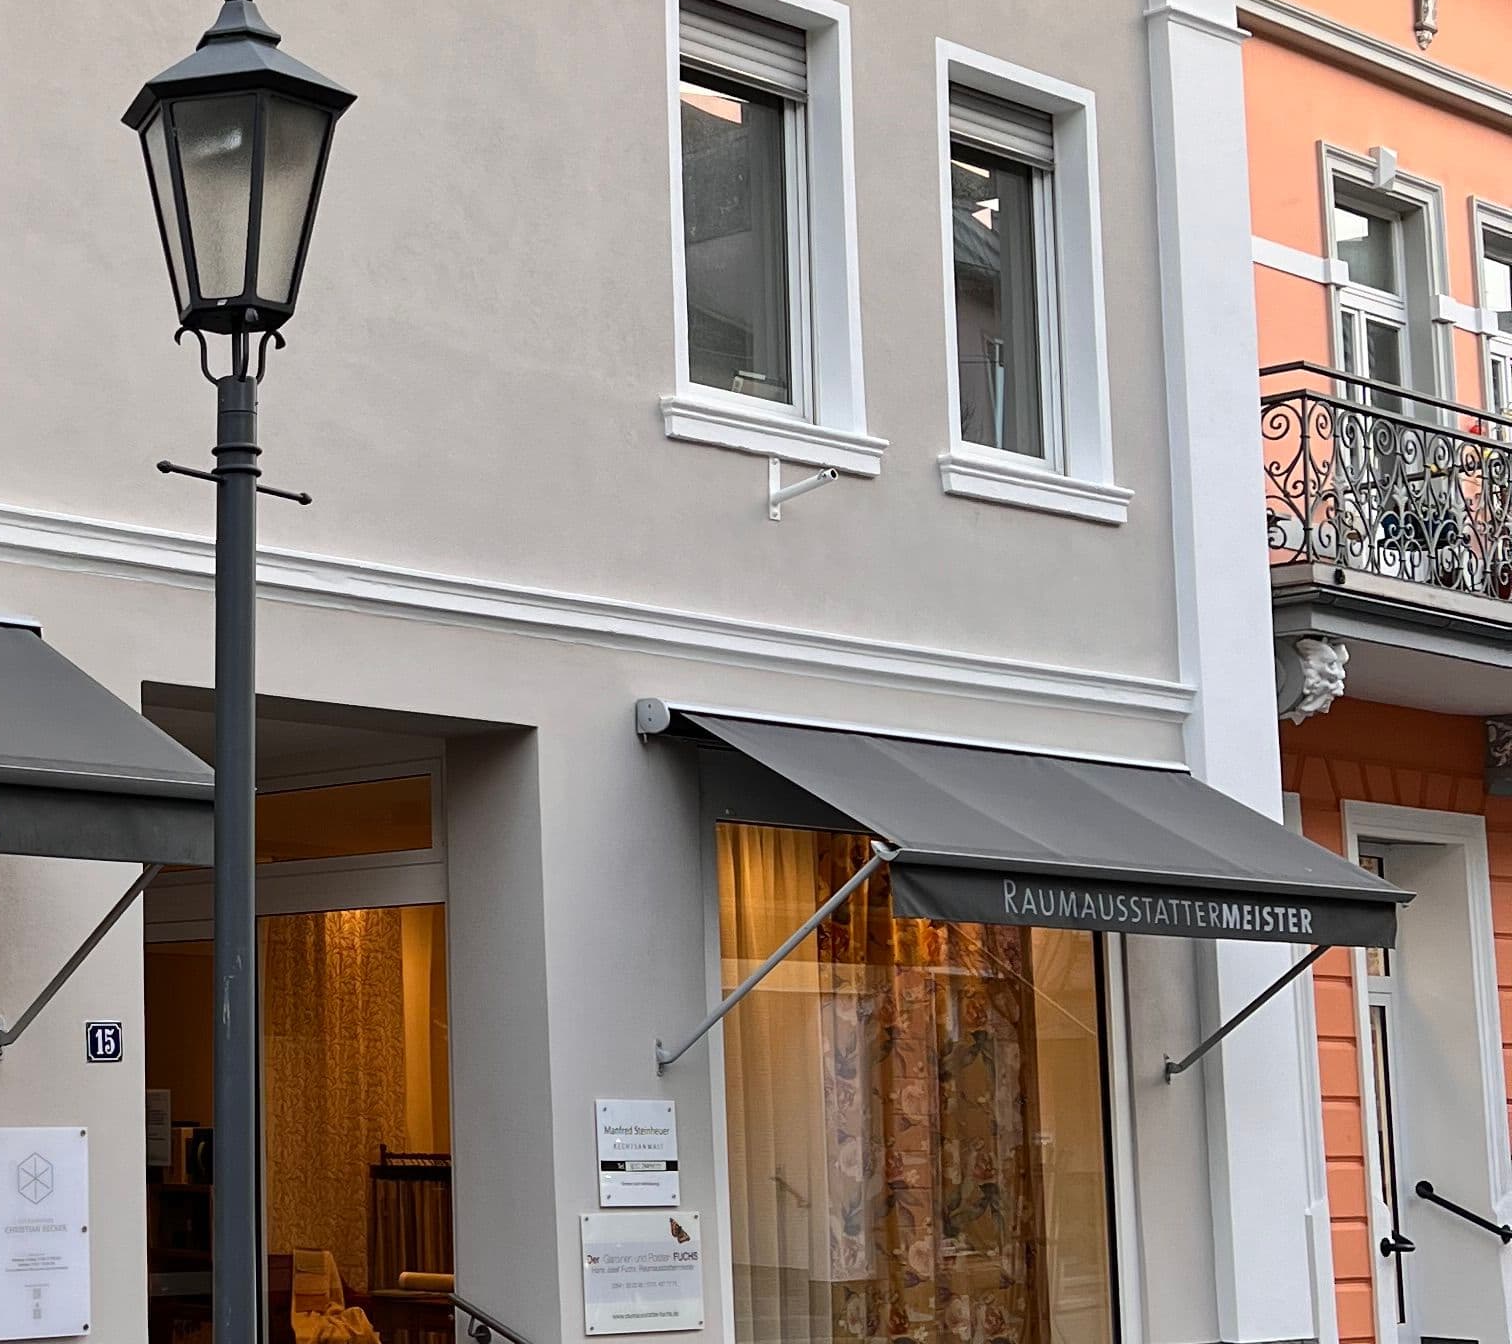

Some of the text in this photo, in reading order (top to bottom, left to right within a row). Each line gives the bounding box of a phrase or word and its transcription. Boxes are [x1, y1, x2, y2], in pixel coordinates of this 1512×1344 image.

[1002, 878, 1313, 935] RAUMAUSSTATTERMEISTER
[95, 1028, 115, 1055] 15
[673, 1251, 698, 1262] FUCHS
